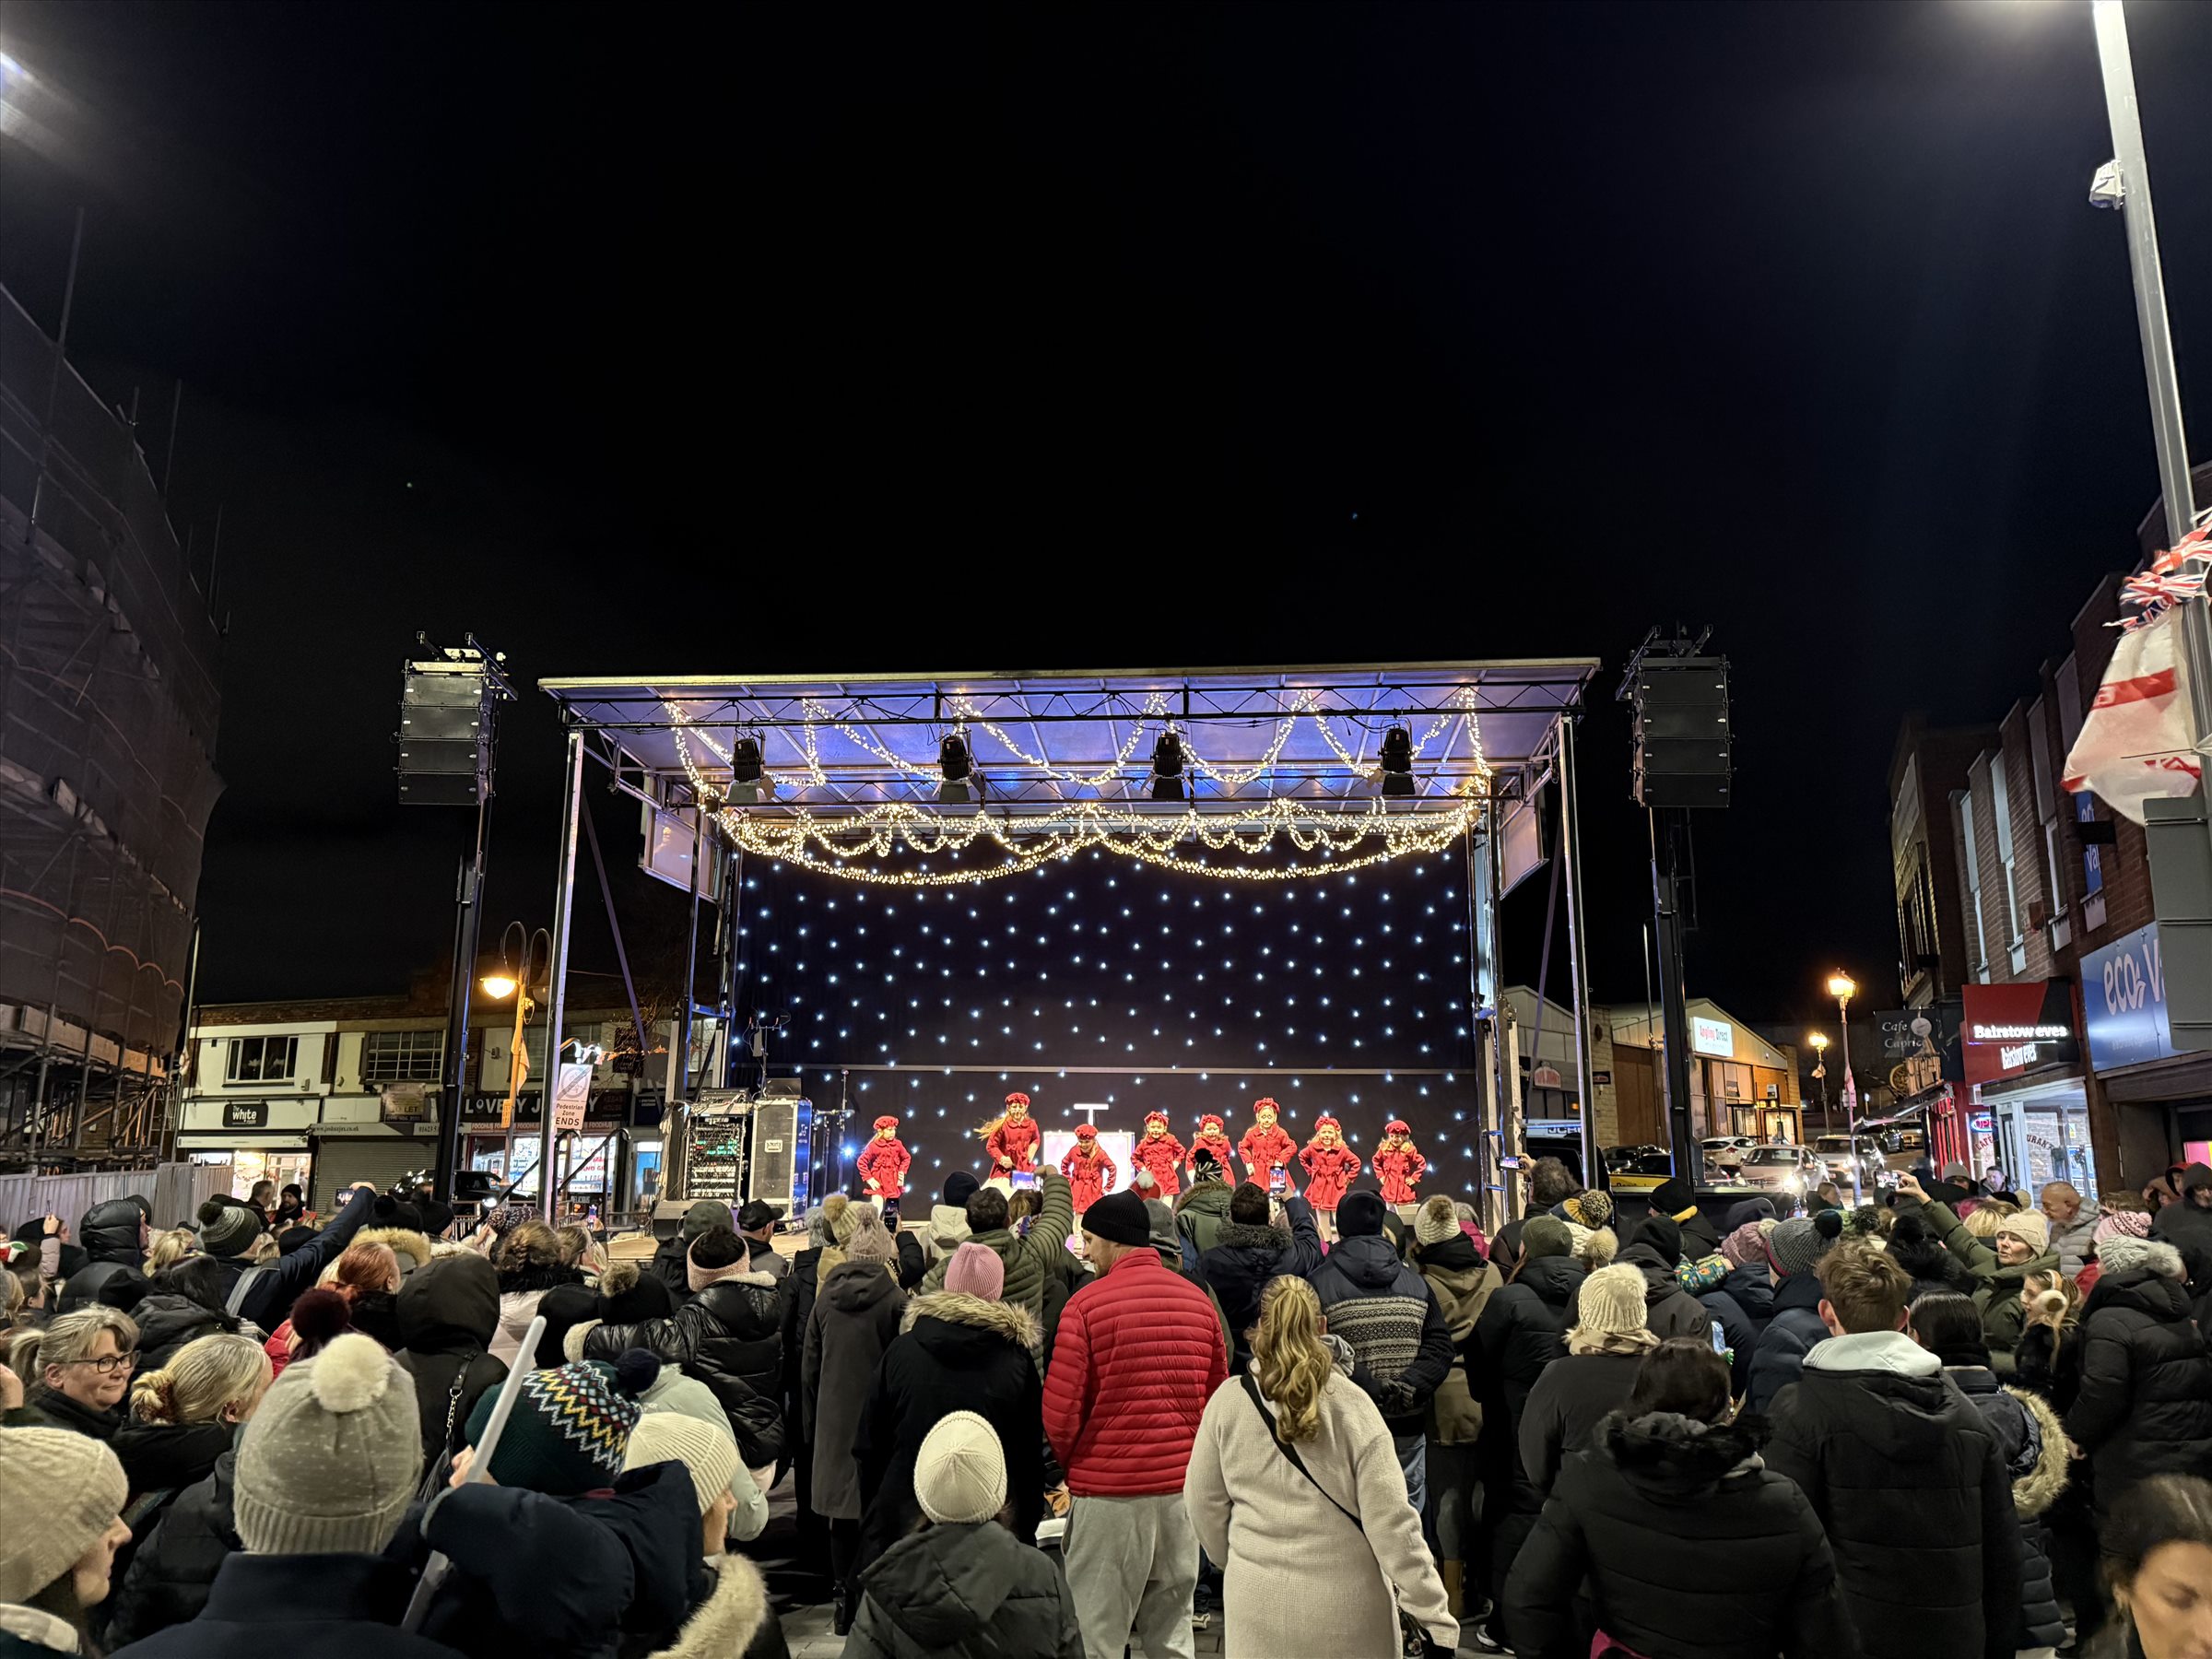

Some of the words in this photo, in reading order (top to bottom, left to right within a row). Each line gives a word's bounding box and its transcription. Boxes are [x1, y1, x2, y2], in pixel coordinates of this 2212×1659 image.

[2103, 952, 2138, 1016] eco
[1881, 1019, 1908, 1032] Cafe
[1973, 1025, 2034, 1039] Bairstow
[2035, 1025, 2067, 1037] eves
[465, 1097, 527, 1115] LOVEY
[232, 1109, 257, 1123] white
[555, 1117, 580, 1126] ENDS
